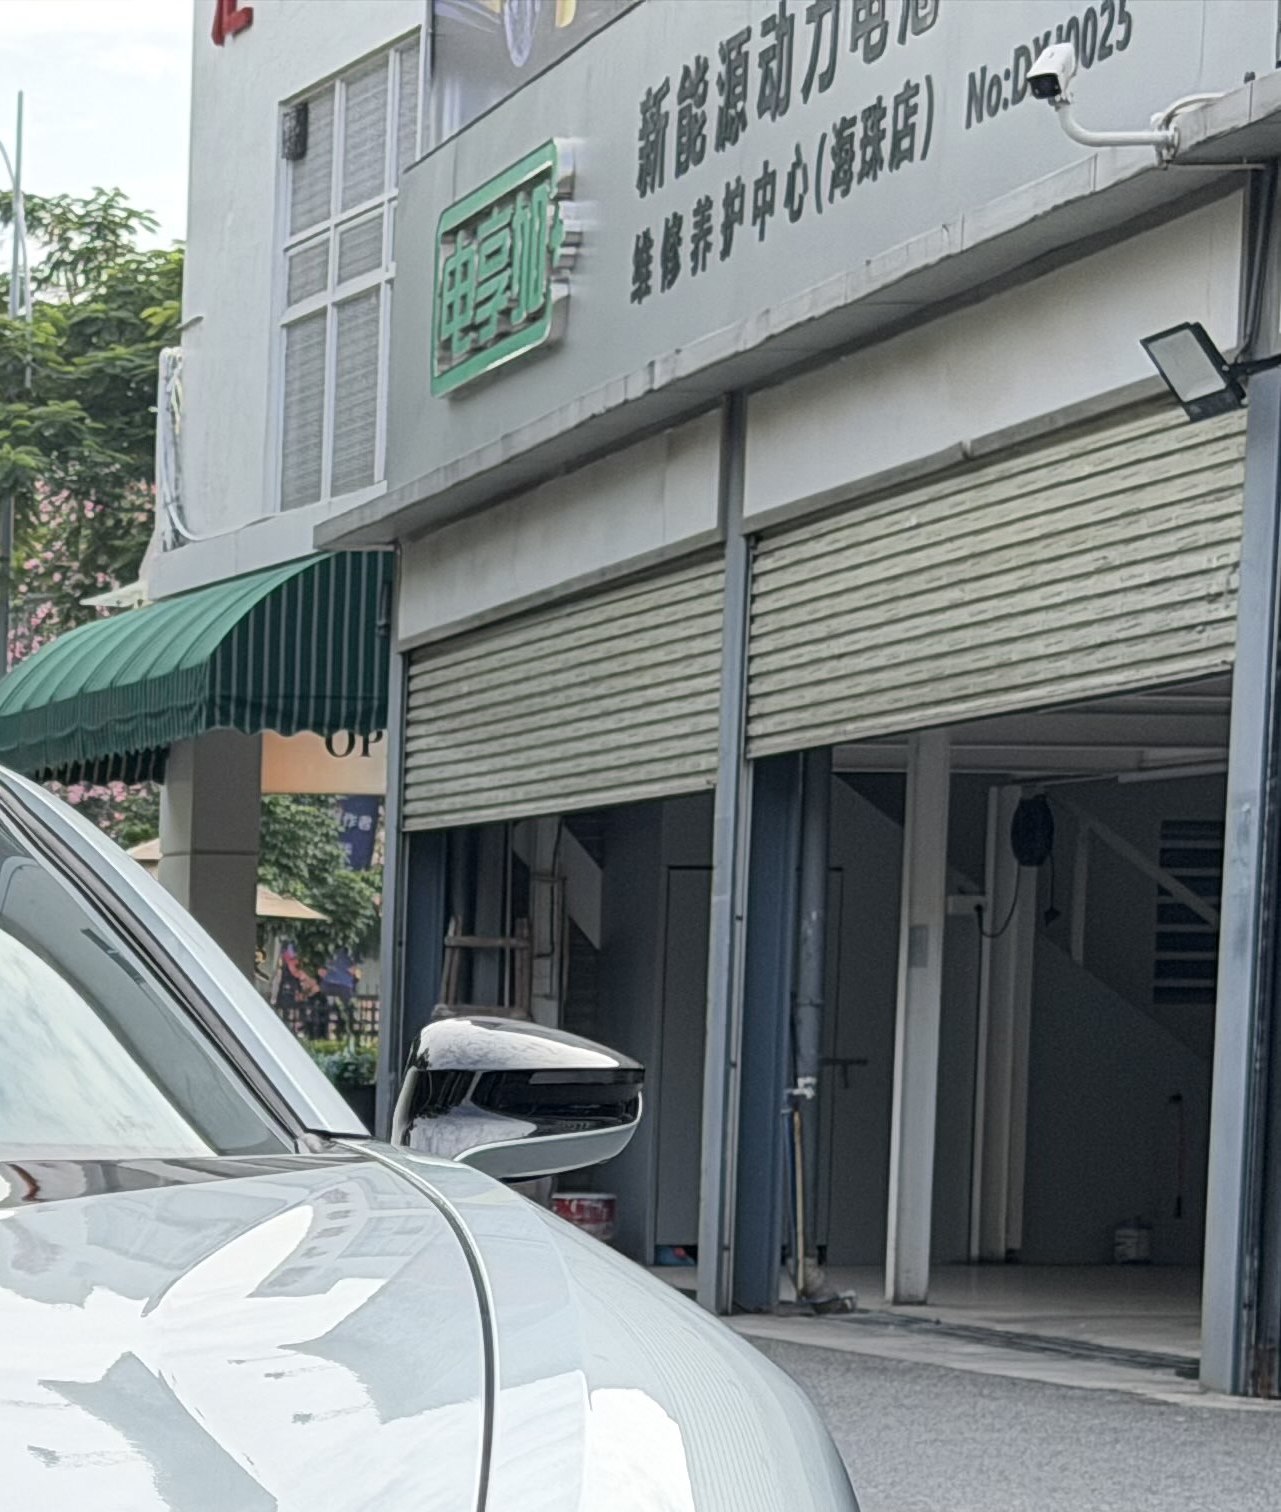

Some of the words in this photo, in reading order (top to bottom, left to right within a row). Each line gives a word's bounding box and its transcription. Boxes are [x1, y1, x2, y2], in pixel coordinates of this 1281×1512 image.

[630, 74, 935, 304] 维修养护中心(海珠店)
